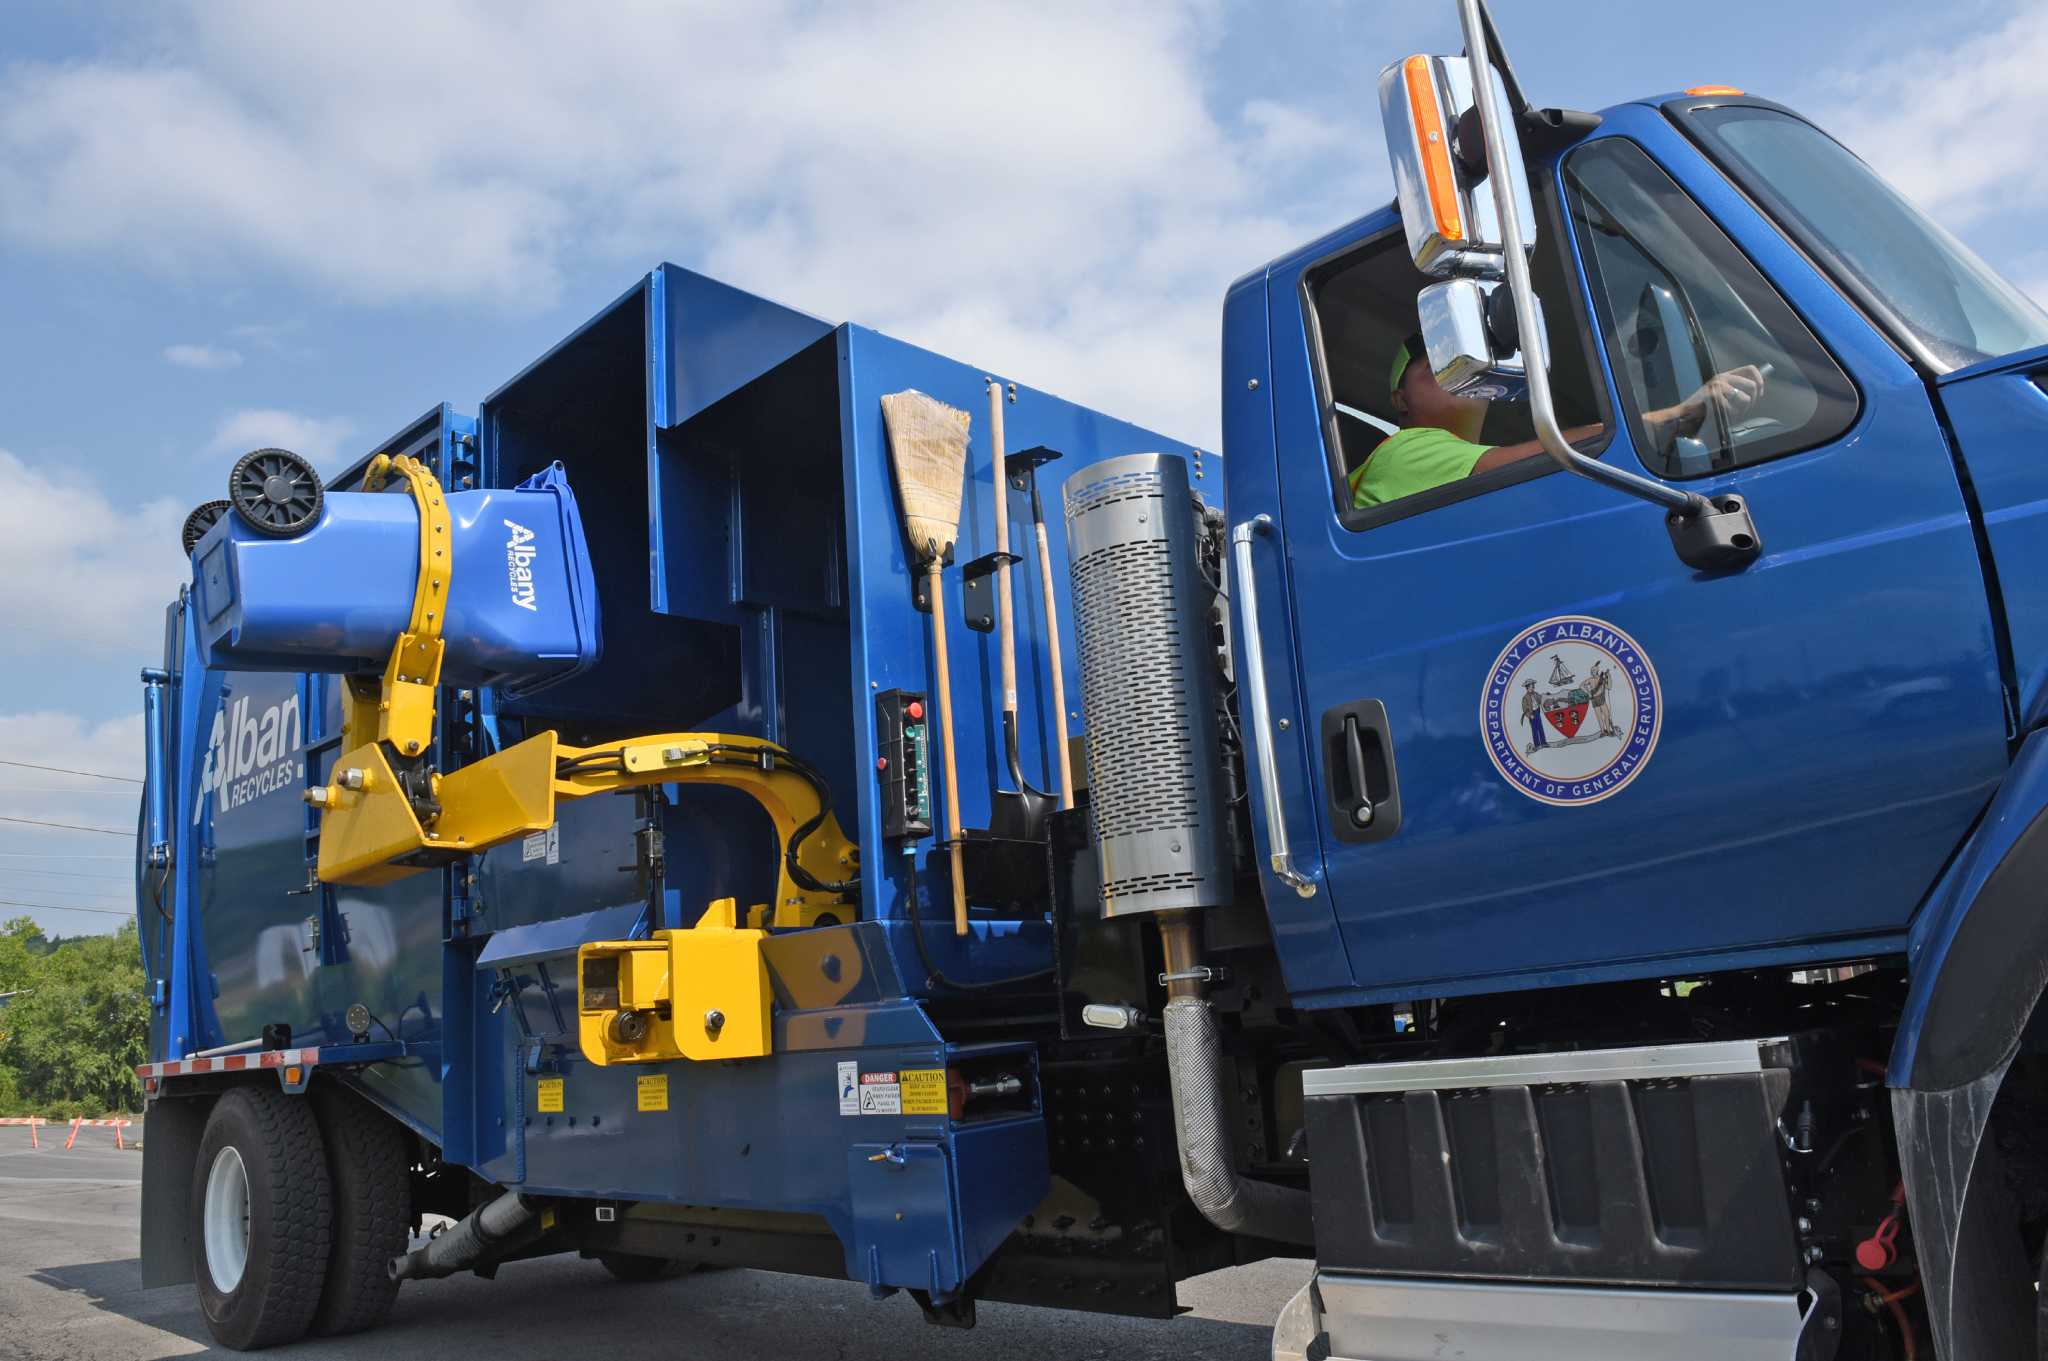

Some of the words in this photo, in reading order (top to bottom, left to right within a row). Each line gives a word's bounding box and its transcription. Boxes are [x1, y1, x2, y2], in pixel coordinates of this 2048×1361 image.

[503, 518, 537, 611] Albany
[1495, 648, 1521, 685] CITY
[1526, 630, 1546, 649] OF
[1555, 625, 1630, 655] ALBANY
[193, 694, 303, 825] Alban
[1488, 701, 1541, 788] DEPARTMENT
[1546, 784, 1565, 796] OF
[1573, 753, 1638, 796] GENERAL
[1632, 665, 1652, 746] SERVICES
[231, 759, 294, 808] RECYCLES
[864, 1073, 893, 1083] DANGER
[908, 1071, 944, 1082] CAUTION
